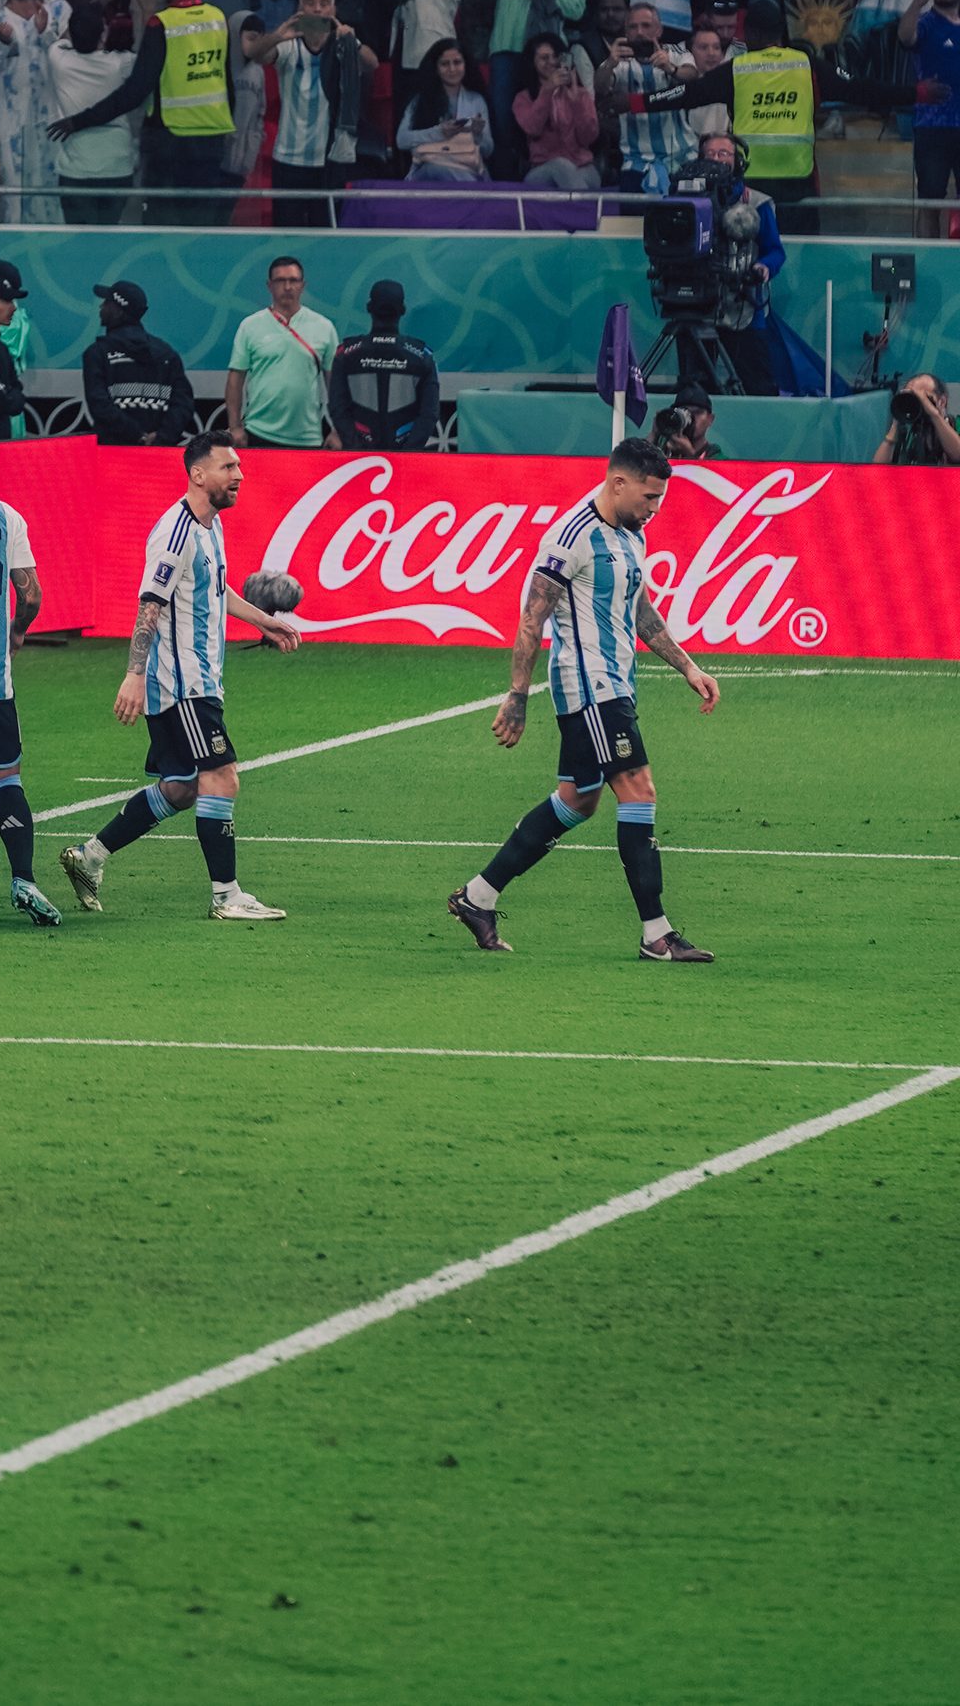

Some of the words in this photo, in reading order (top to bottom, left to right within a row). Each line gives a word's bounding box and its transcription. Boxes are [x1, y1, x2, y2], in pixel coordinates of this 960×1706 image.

[752, 91, 799, 106] 3549
[752, 109, 798, 123] Security
[623, 567, 643, 601] 19
